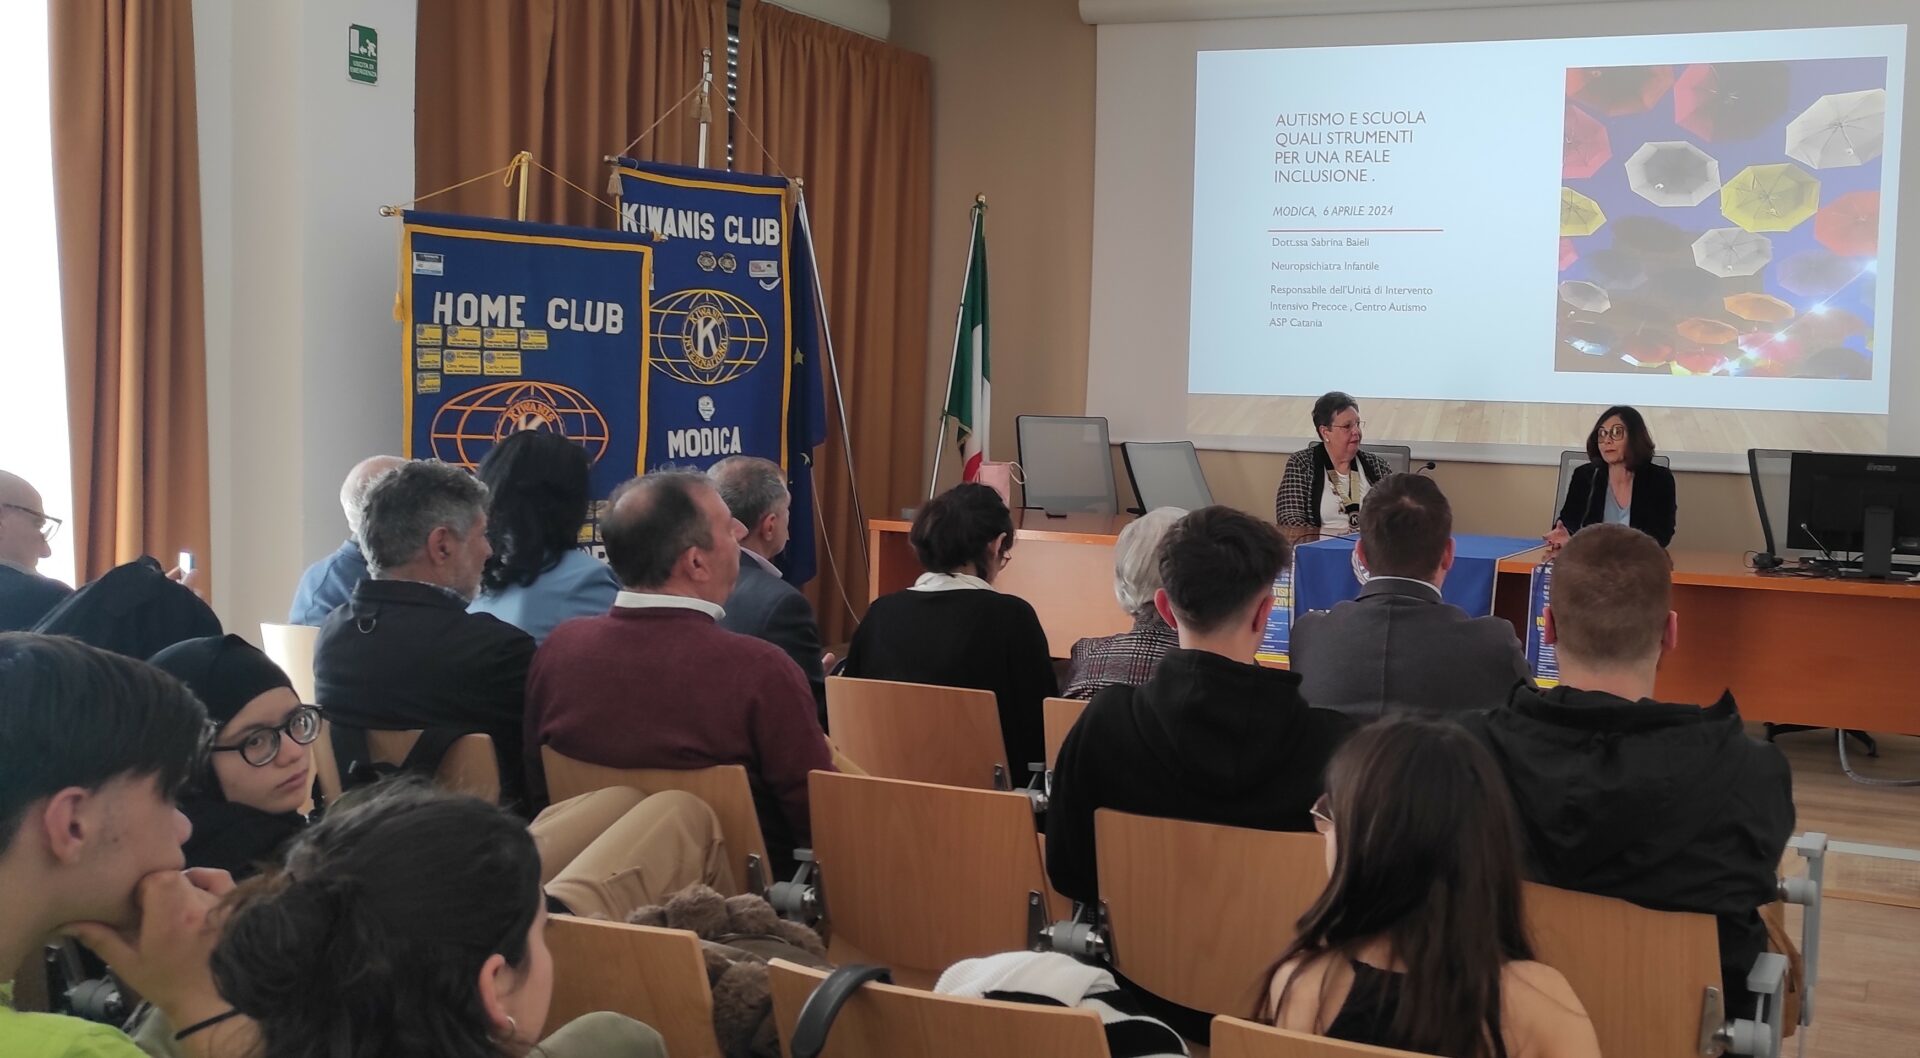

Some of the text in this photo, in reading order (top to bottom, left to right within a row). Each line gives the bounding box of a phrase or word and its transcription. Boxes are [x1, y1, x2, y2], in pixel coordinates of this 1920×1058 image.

[1275, 110, 1426, 127] AUTISMO E SCUOLA
[1275, 130, 1413, 147] QUALI STRUMENTI
[1275, 149, 1390, 164] PER UNA REALE
[1274, 169, 1368, 183] INCLUSIONE
[1272, 205, 1394, 217] MODICA, 6 APRILE 2024
[622, 202, 780, 246] KIWANIS CLUB
[1311, 238, 1343, 247] Sabrina
[1346, 238, 1370, 247] Baieli
[1271, 261, 1380, 272] Neuropsichiatra Infantile
[1270, 285, 1327, 296] Responsabile
[1374, 285, 1382, 295] di
[1385, 285, 1433, 295] Intervento
[433, 291, 624, 335] HOME CLUB
[1270, 302, 1309, 311] Intensivo
[1312, 302, 1347, 312] Precoce
[1354, 302, 1387, 312] Centro
[1389, 302, 1427, 312] Autismo
[688, 306, 724, 325] KIWANIS
[1269, 318, 1323, 328] ASP Catania
[506, 402, 556, 423] KIWANIS
[667, 426, 742, 459] MODICA
